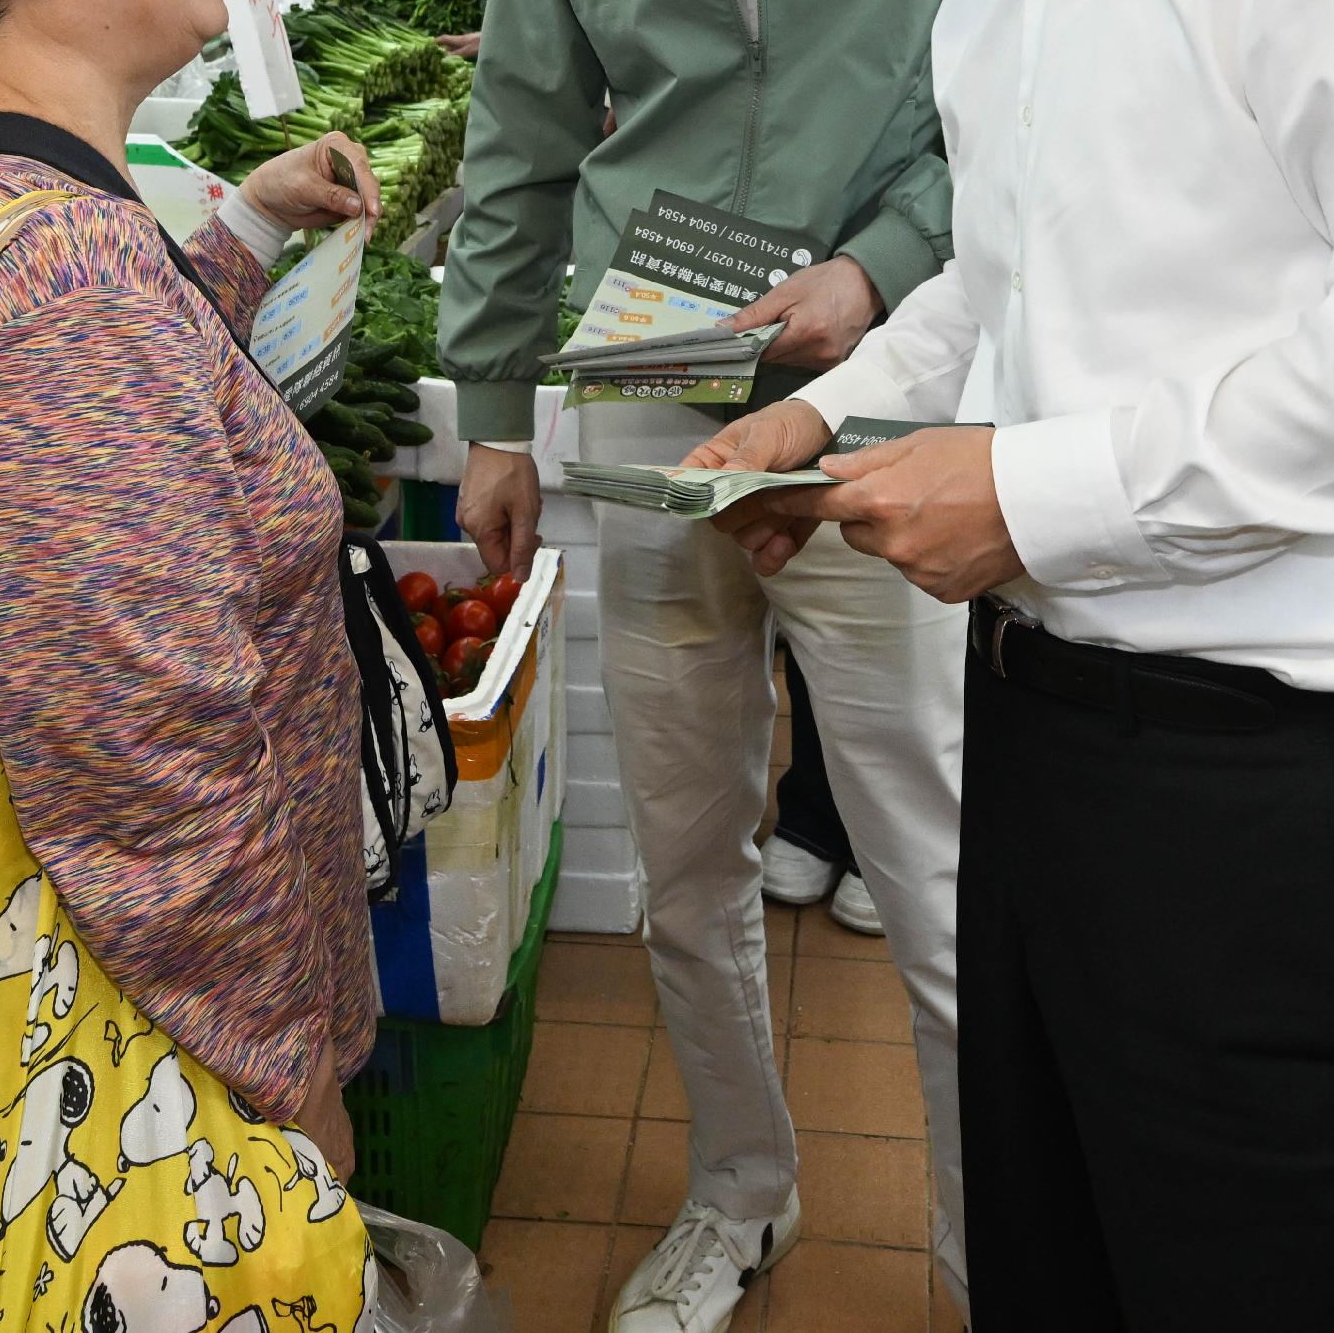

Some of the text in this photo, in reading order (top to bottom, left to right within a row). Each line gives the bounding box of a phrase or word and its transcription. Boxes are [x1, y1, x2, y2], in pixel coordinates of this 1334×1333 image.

[658, 206, 686, 224] 4584
[634, 225, 663, 243] 4584
[688, 217, 718, 235] 6904
[666, 235, 695, 254] 6904
[727, 228, 758, 247] 0297
[703, 249, 734, 267] 0297
[760, 240, 789, 258] 9741
[737, 261, 766, 278] 9741
